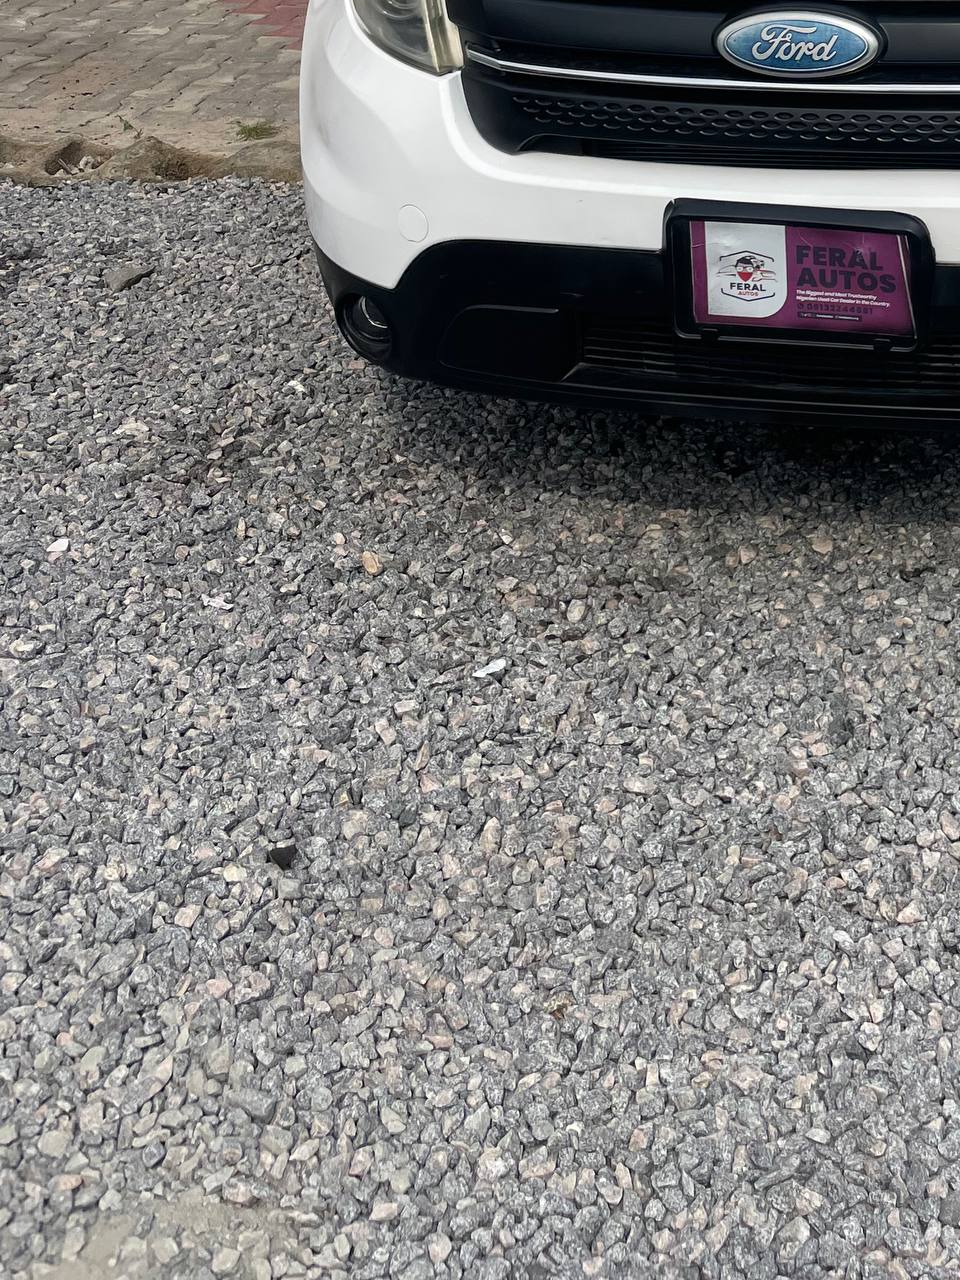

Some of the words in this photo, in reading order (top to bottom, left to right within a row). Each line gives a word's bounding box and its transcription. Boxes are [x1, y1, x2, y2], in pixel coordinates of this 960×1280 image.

[752, 24, 839, 61] Ford
[796, 245, 883, 270] FERAL
[730, 282, 767, 291] FERAL
[796, 268, 896, 293] AUTOS
